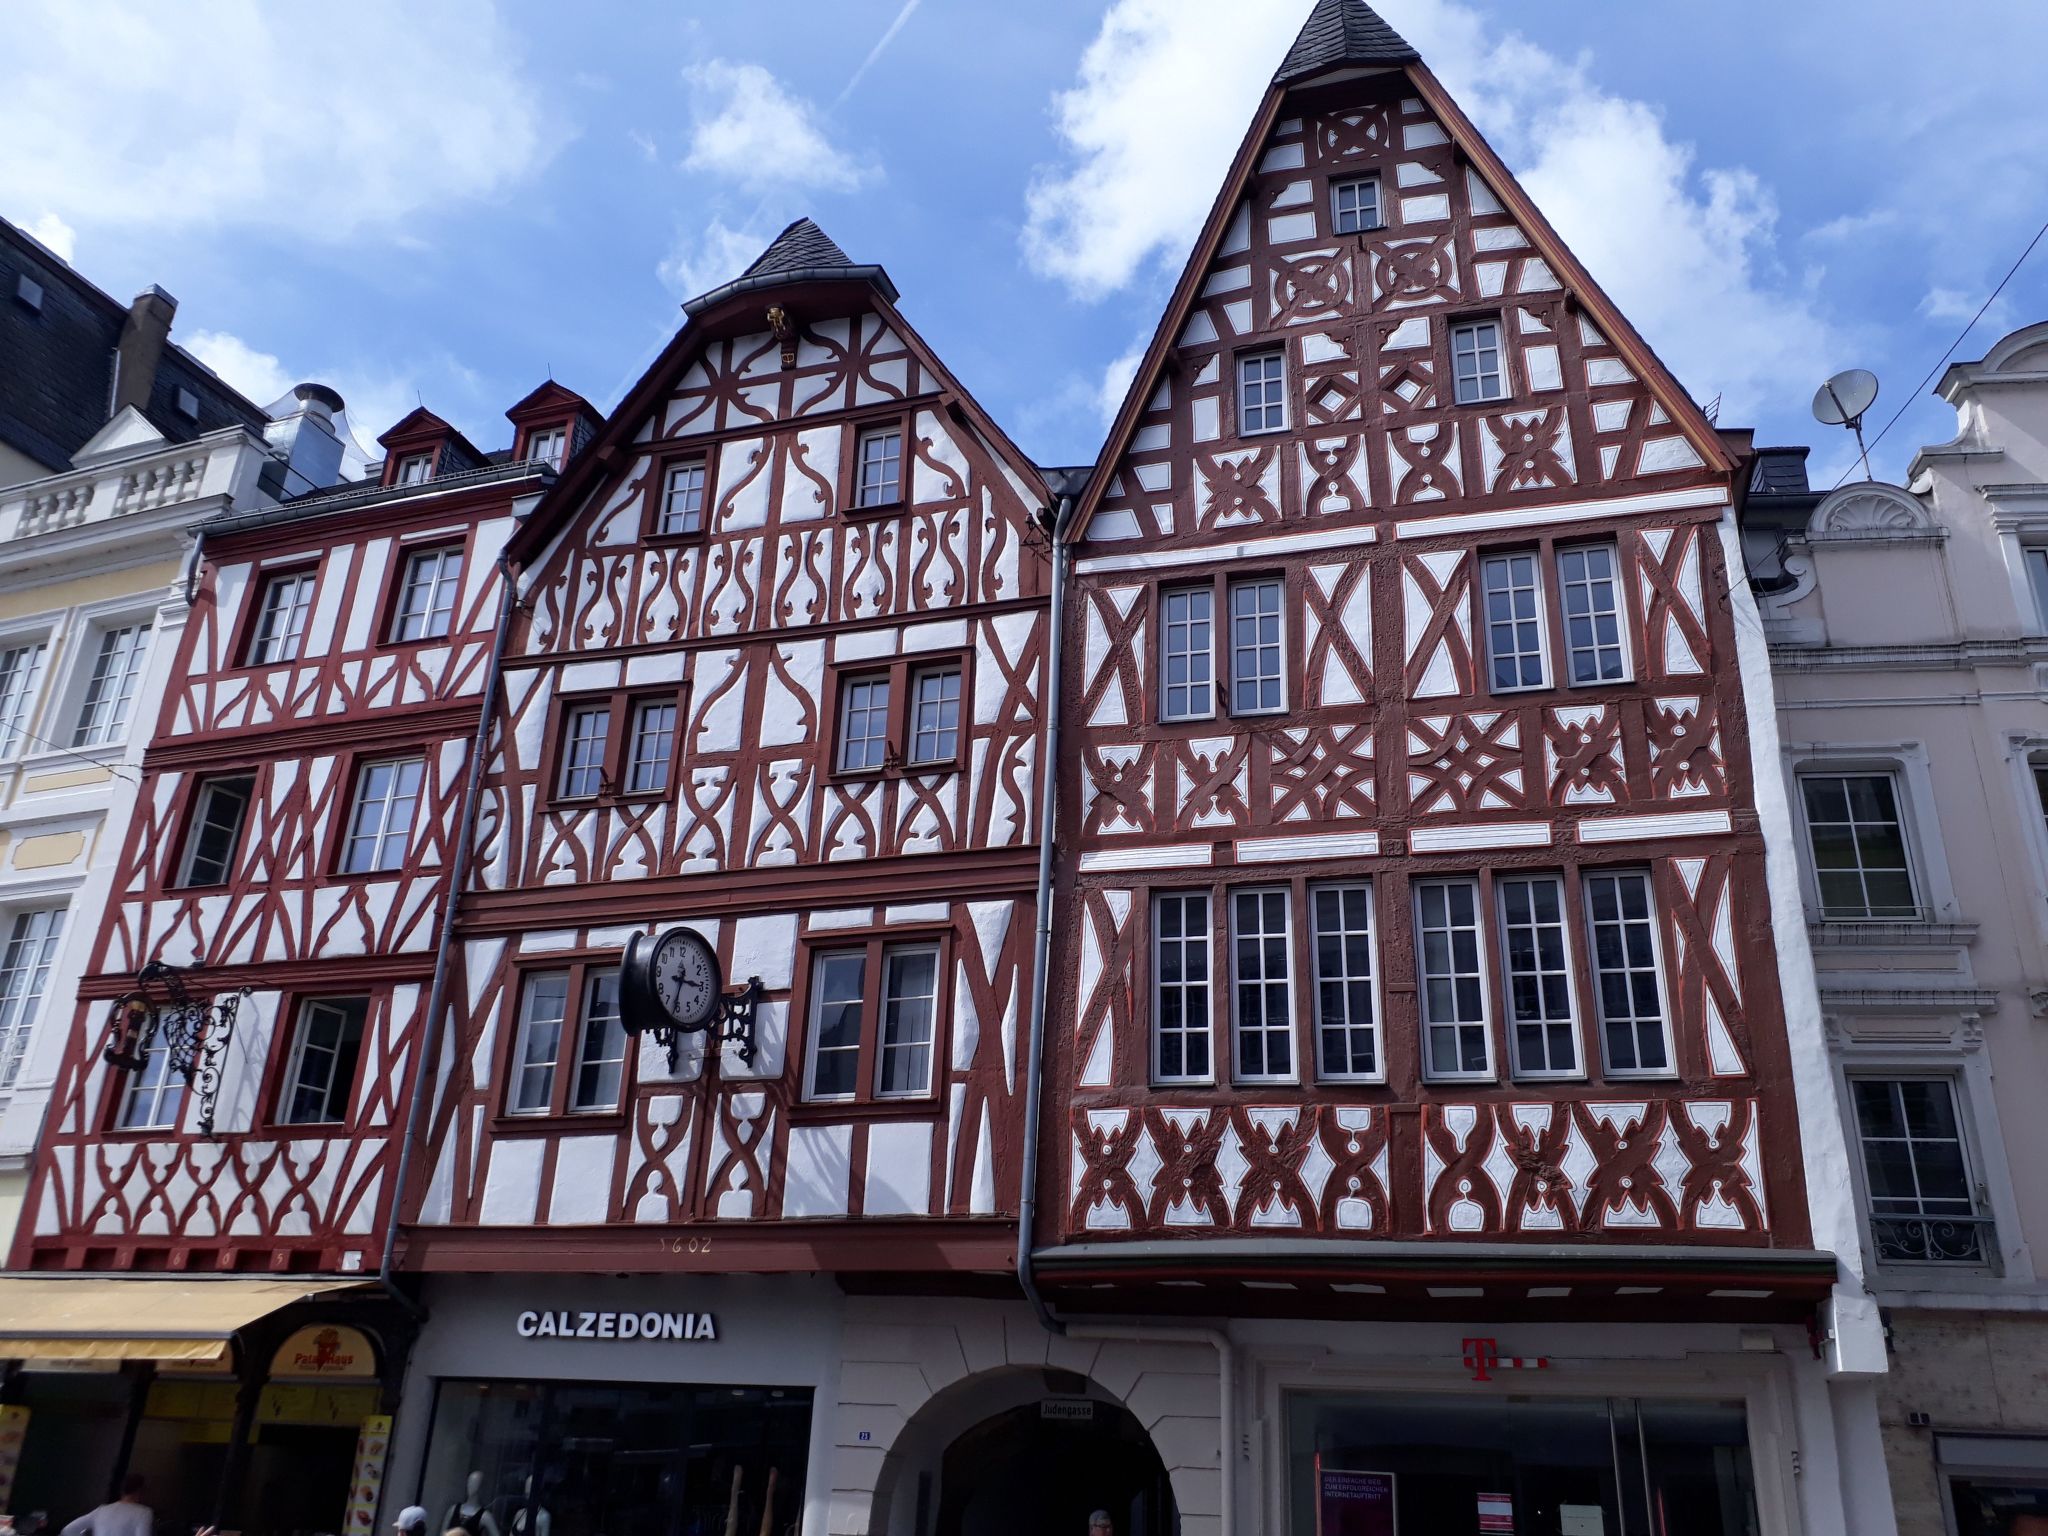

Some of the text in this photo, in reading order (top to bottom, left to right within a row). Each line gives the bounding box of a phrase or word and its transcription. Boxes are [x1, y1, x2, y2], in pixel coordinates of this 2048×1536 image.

[680, 946, 686, 958] 12
[662, 953, 668, 964] 10
[656, 964, 702, 978] 9 2
[658, 982, 704, 994] 8 3
[666, 994, 700, 1006] 7 4
[686, 1001, 691, 1012] 5
[660, 1237, 712, 1253] 1602
[516, 1310, 716, 1340] CALZEDONIA
[1043, 1402, 1092, 1417] Judengasse
[1324, 1490, 1381, 1500] INTERNETAUFTRITT
